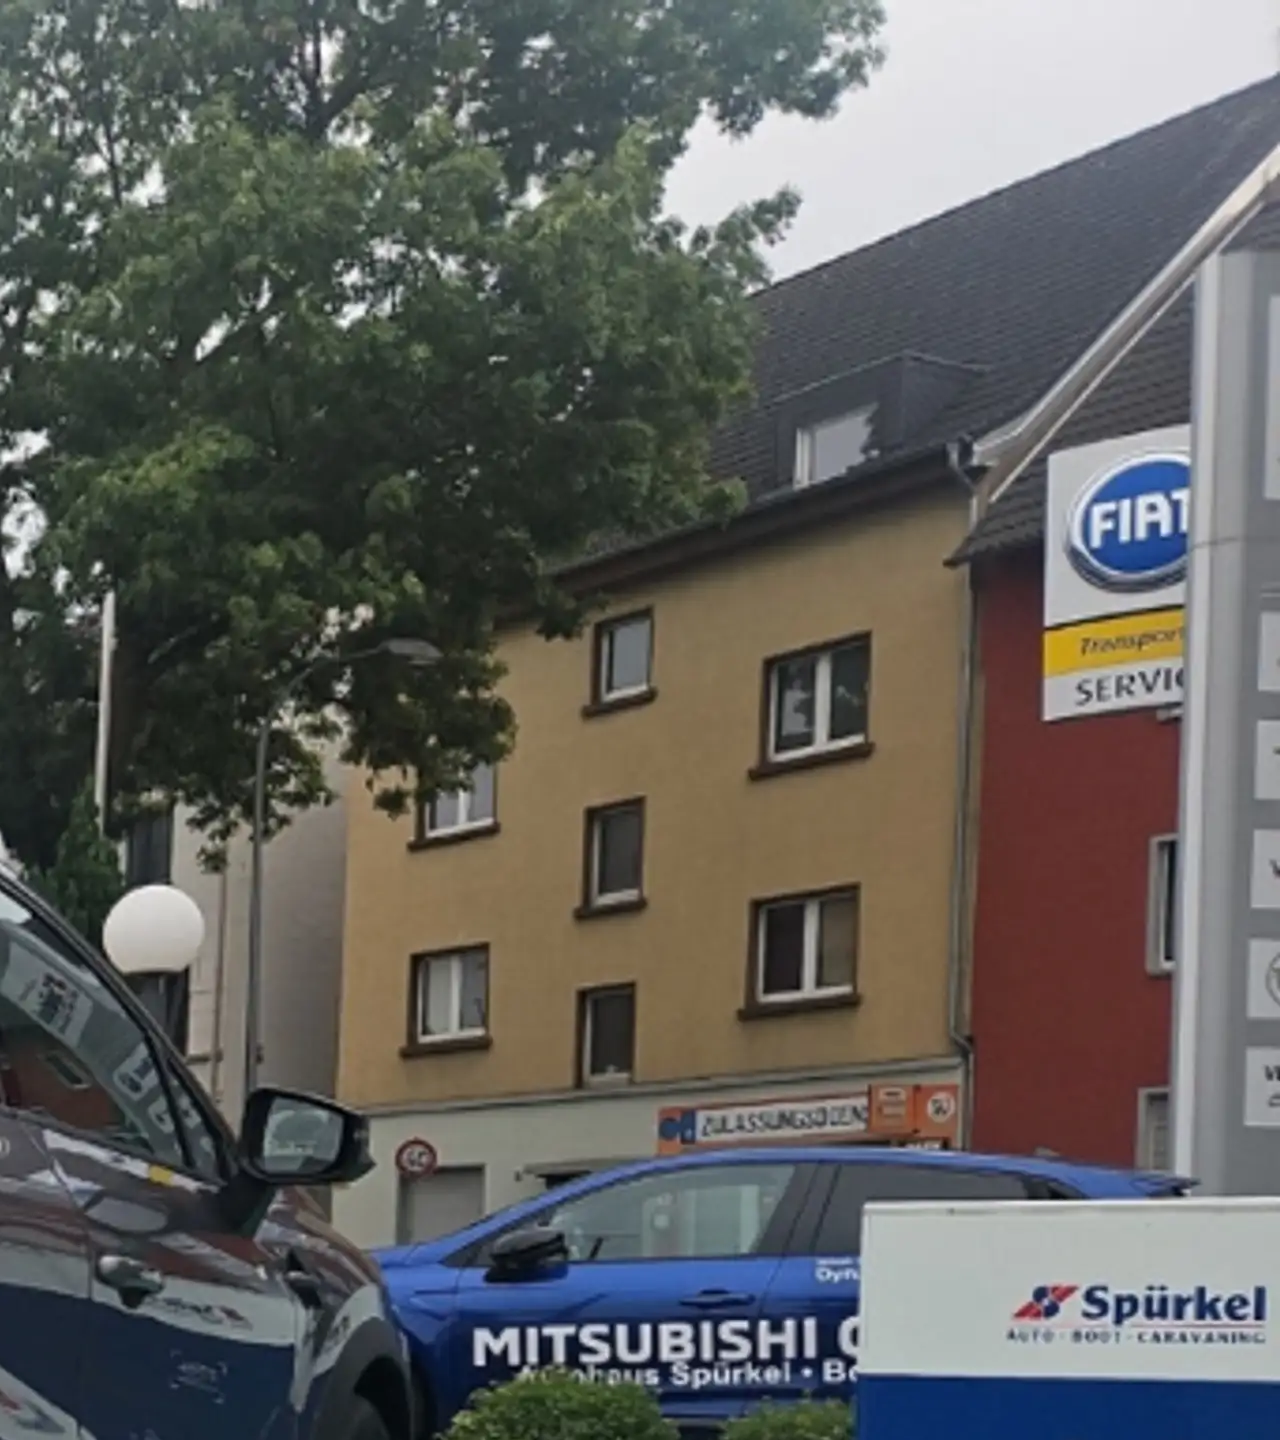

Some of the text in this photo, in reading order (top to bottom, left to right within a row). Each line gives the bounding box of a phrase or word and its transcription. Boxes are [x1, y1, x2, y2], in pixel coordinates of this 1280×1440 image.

[1080, 628, 1183, 655] Transpor
[1081, 1284, 1267, 1326] Spürkel
[473, 1315, 817, 1367] MITSUBISHI
[1006, 1328, 1267, 1345] AUTO BOOT CARAVANING
[669, 1357, 791, 1390] Spürkel
